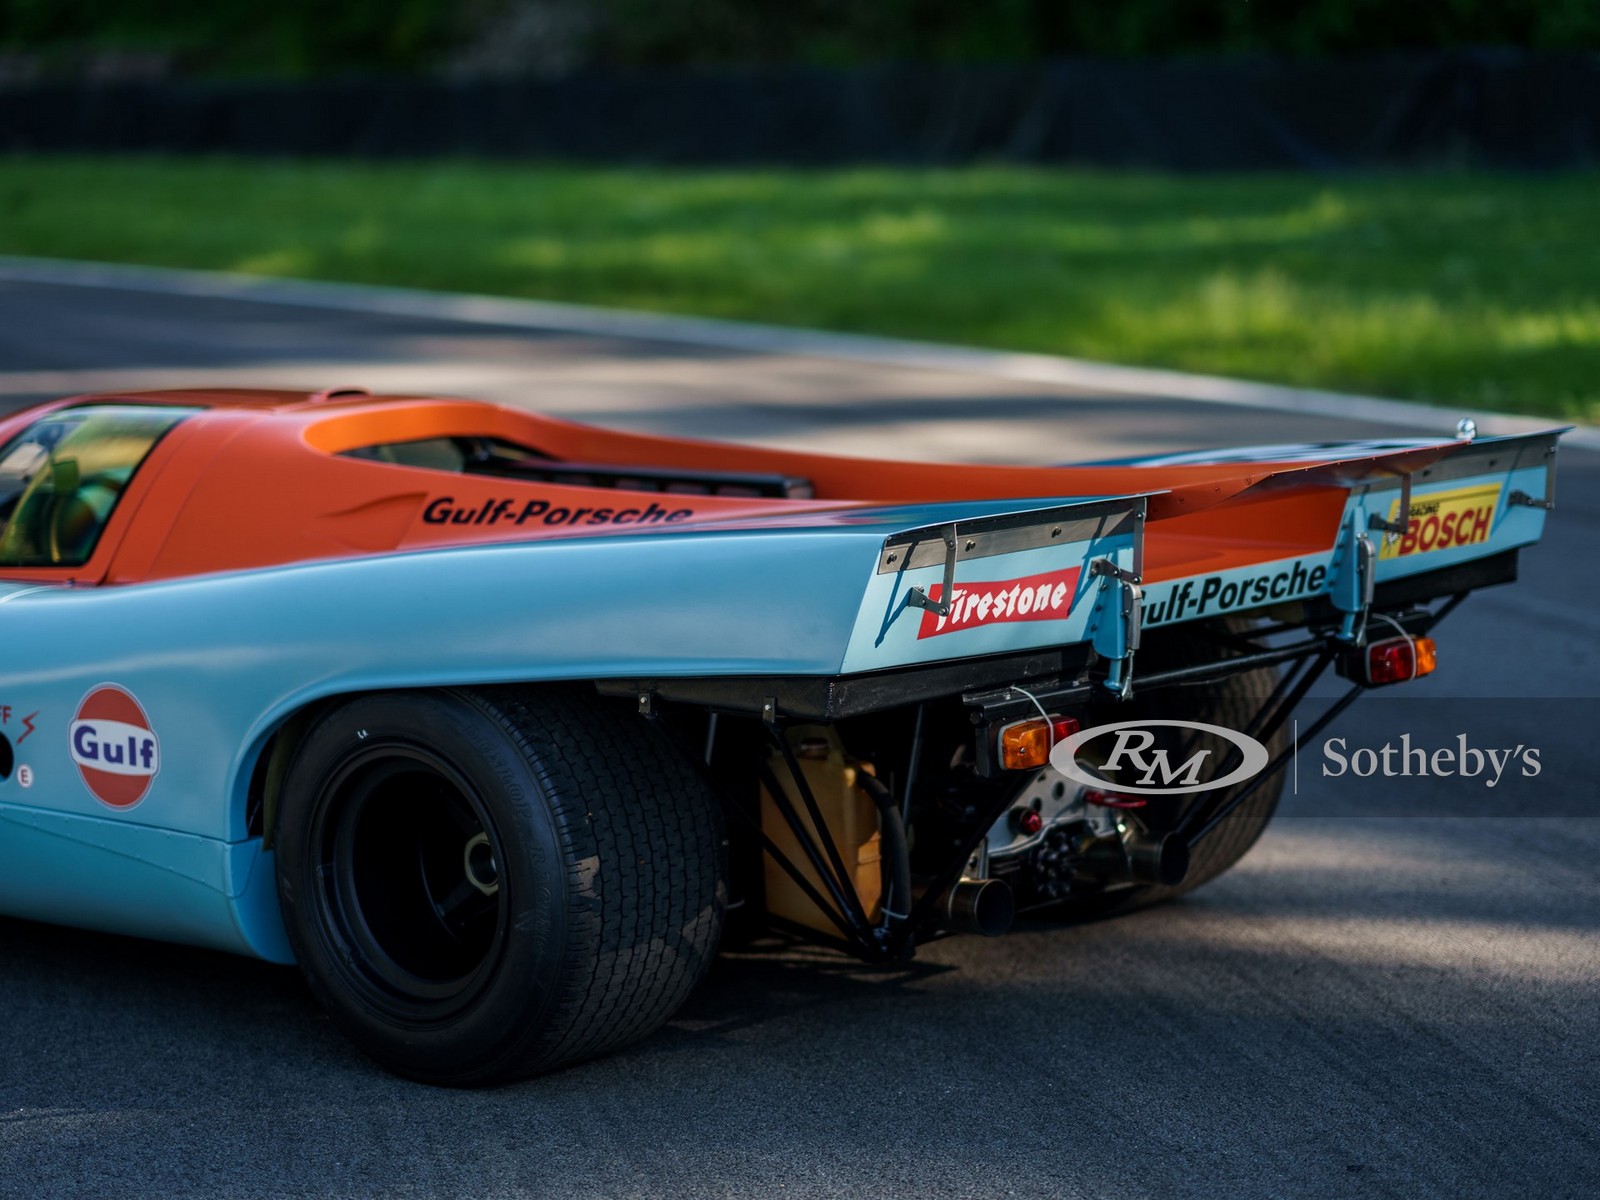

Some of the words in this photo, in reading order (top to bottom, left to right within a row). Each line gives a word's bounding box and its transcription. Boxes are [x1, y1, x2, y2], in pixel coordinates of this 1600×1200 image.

[422, 496, 694, 525] Gulf-Porsche
[1397, 505, 1493, 556] BOSCH
[74, 725, 154, 769] Gulf
